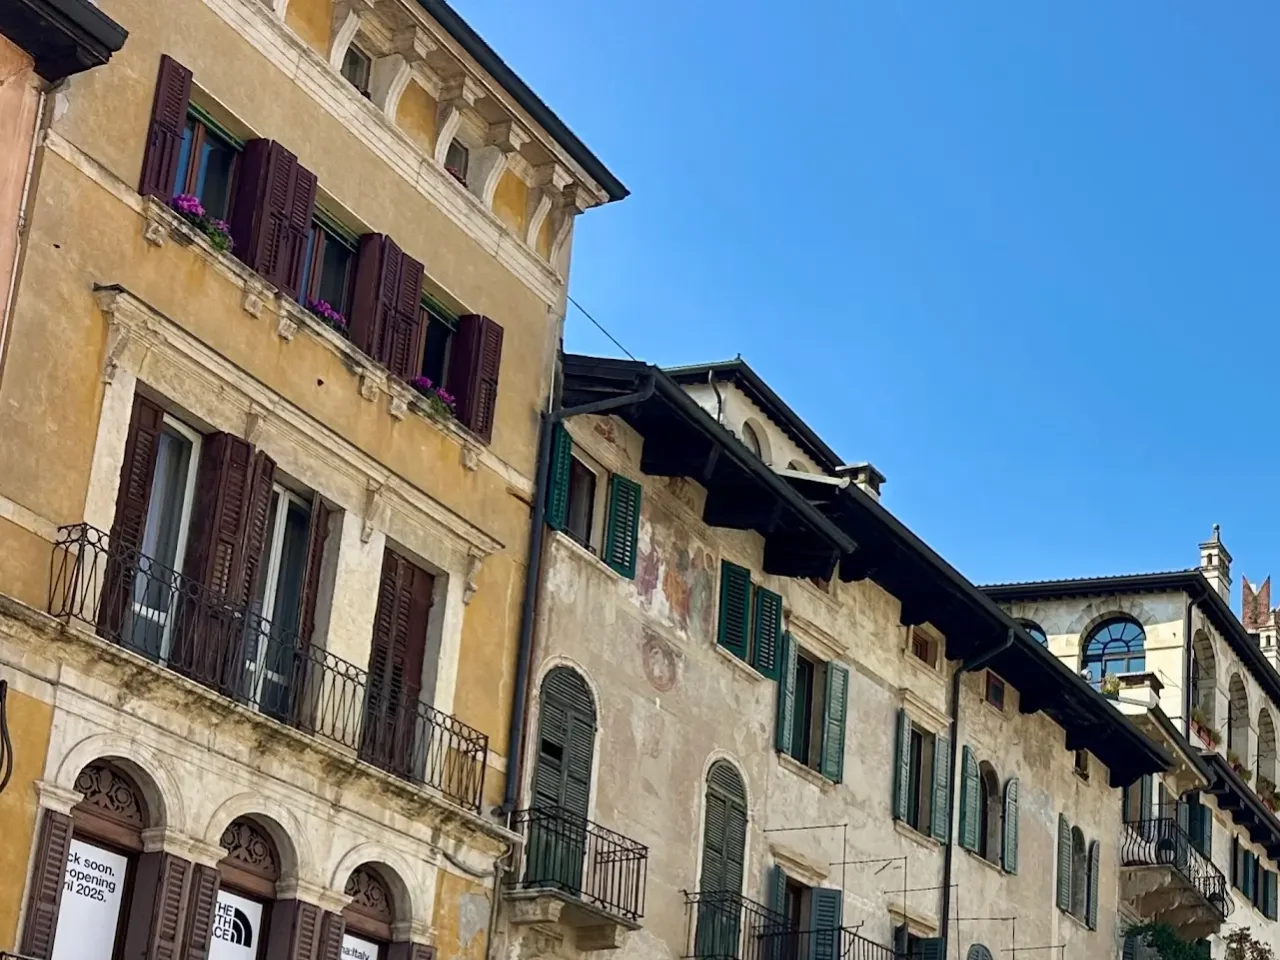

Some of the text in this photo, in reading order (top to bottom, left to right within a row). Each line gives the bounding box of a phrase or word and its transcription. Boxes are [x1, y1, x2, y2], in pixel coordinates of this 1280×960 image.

[67, 852, 115, 877] ck soon.
[65, 868, 117, 894] -opening
[76, 883, 107, 903] 2025.
[214, 926, 231, 941] CE
